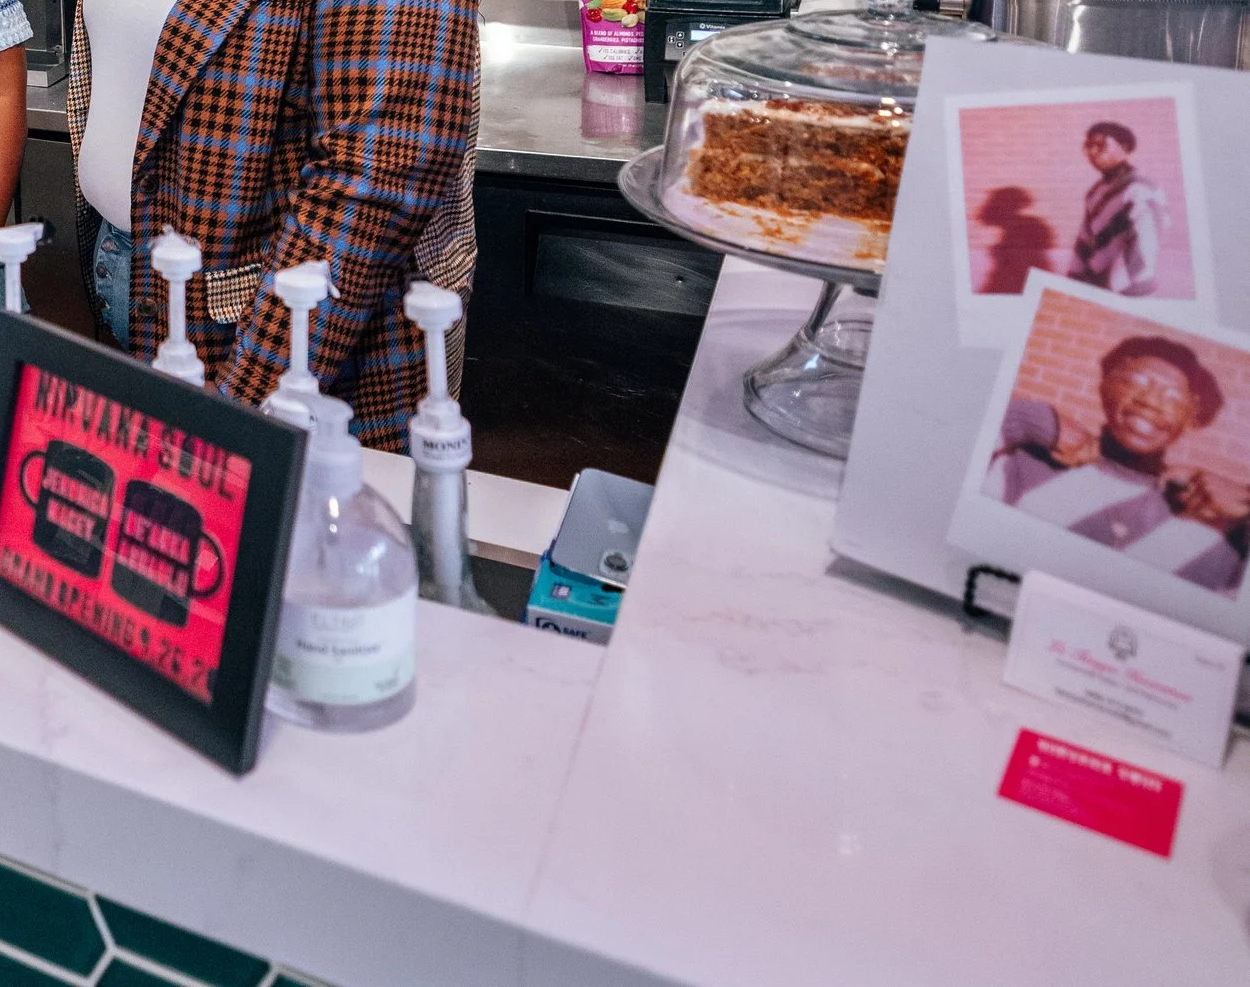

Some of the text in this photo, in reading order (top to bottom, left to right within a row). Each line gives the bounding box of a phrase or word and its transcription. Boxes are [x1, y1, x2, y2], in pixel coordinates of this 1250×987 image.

[34, 370, 240, 502] NIRVANA SOUL
[562, 627, 588, 639] SAFE
